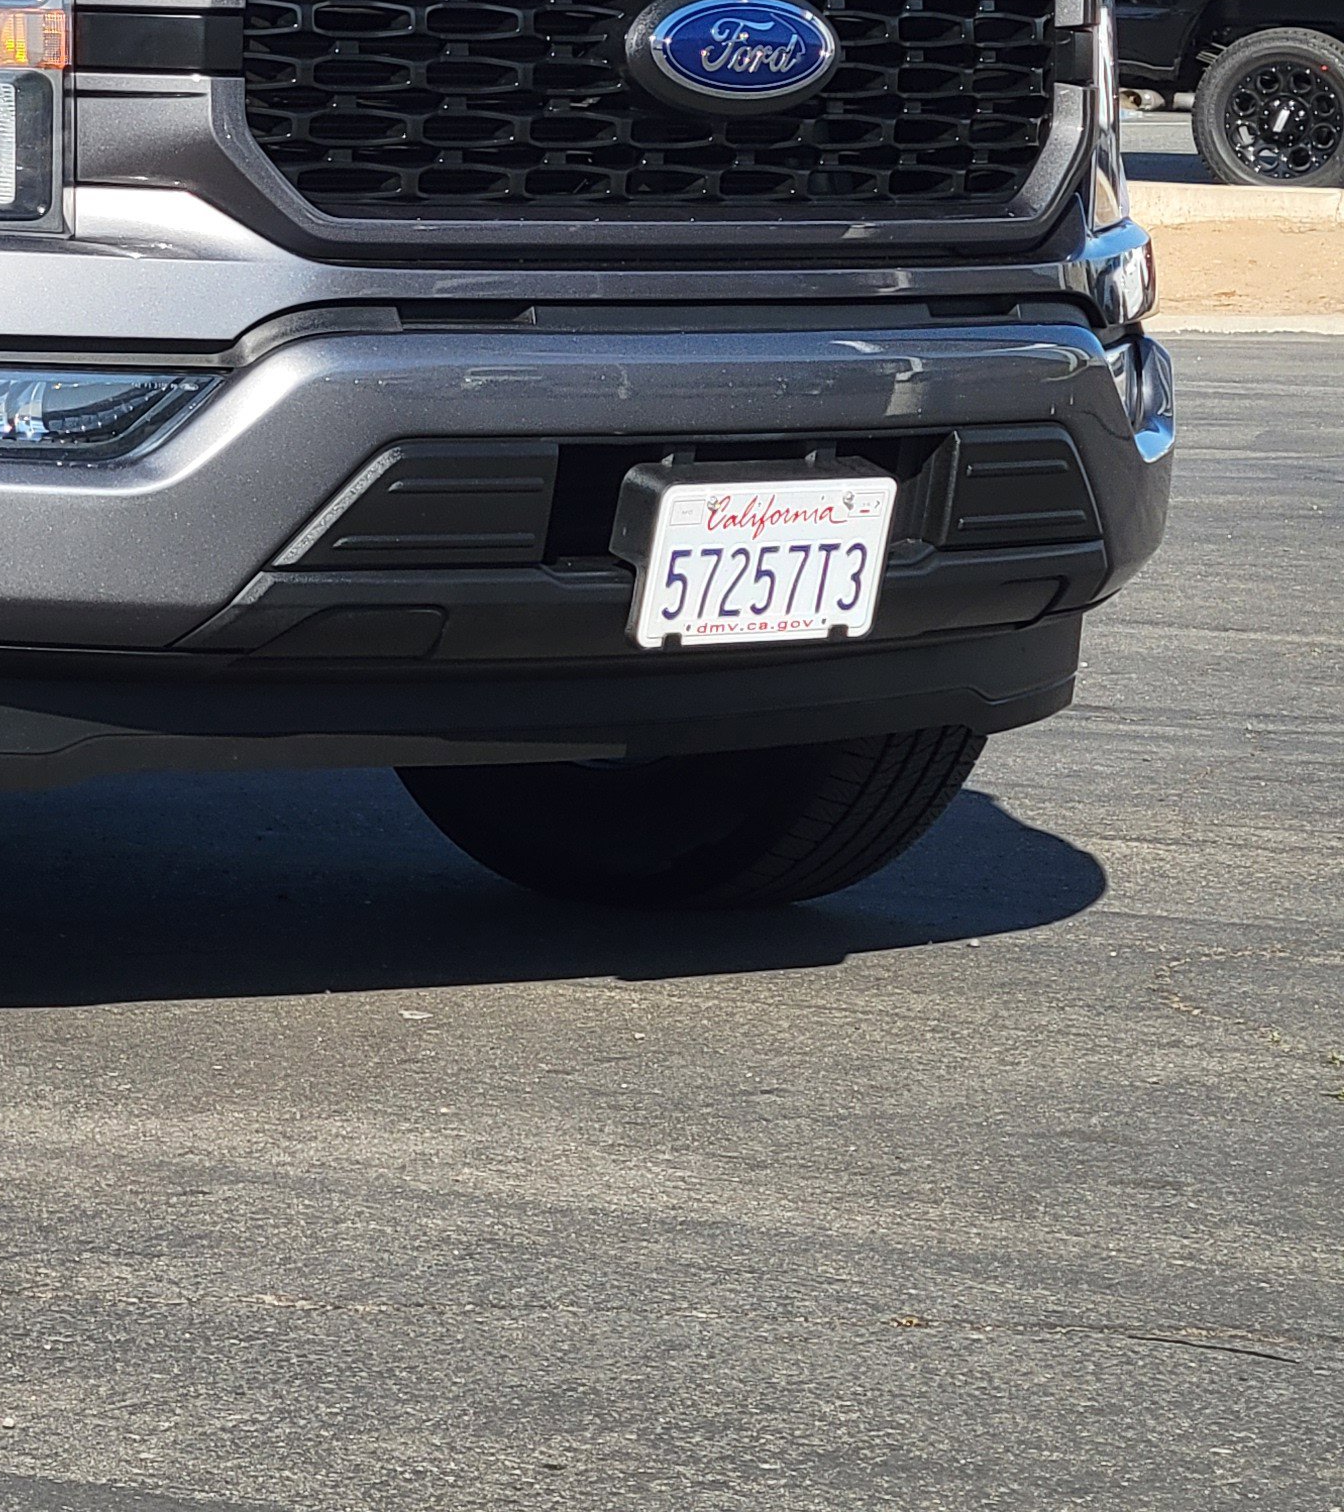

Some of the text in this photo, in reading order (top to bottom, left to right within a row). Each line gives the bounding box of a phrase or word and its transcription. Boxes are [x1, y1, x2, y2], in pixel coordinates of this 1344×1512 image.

[700, 13, 806, 73] Ford
[706, 494, 848, 540] California
[661, 541, 868, 620] 57257T3
[696, 618, 814, 634] dmv.ca.gov
